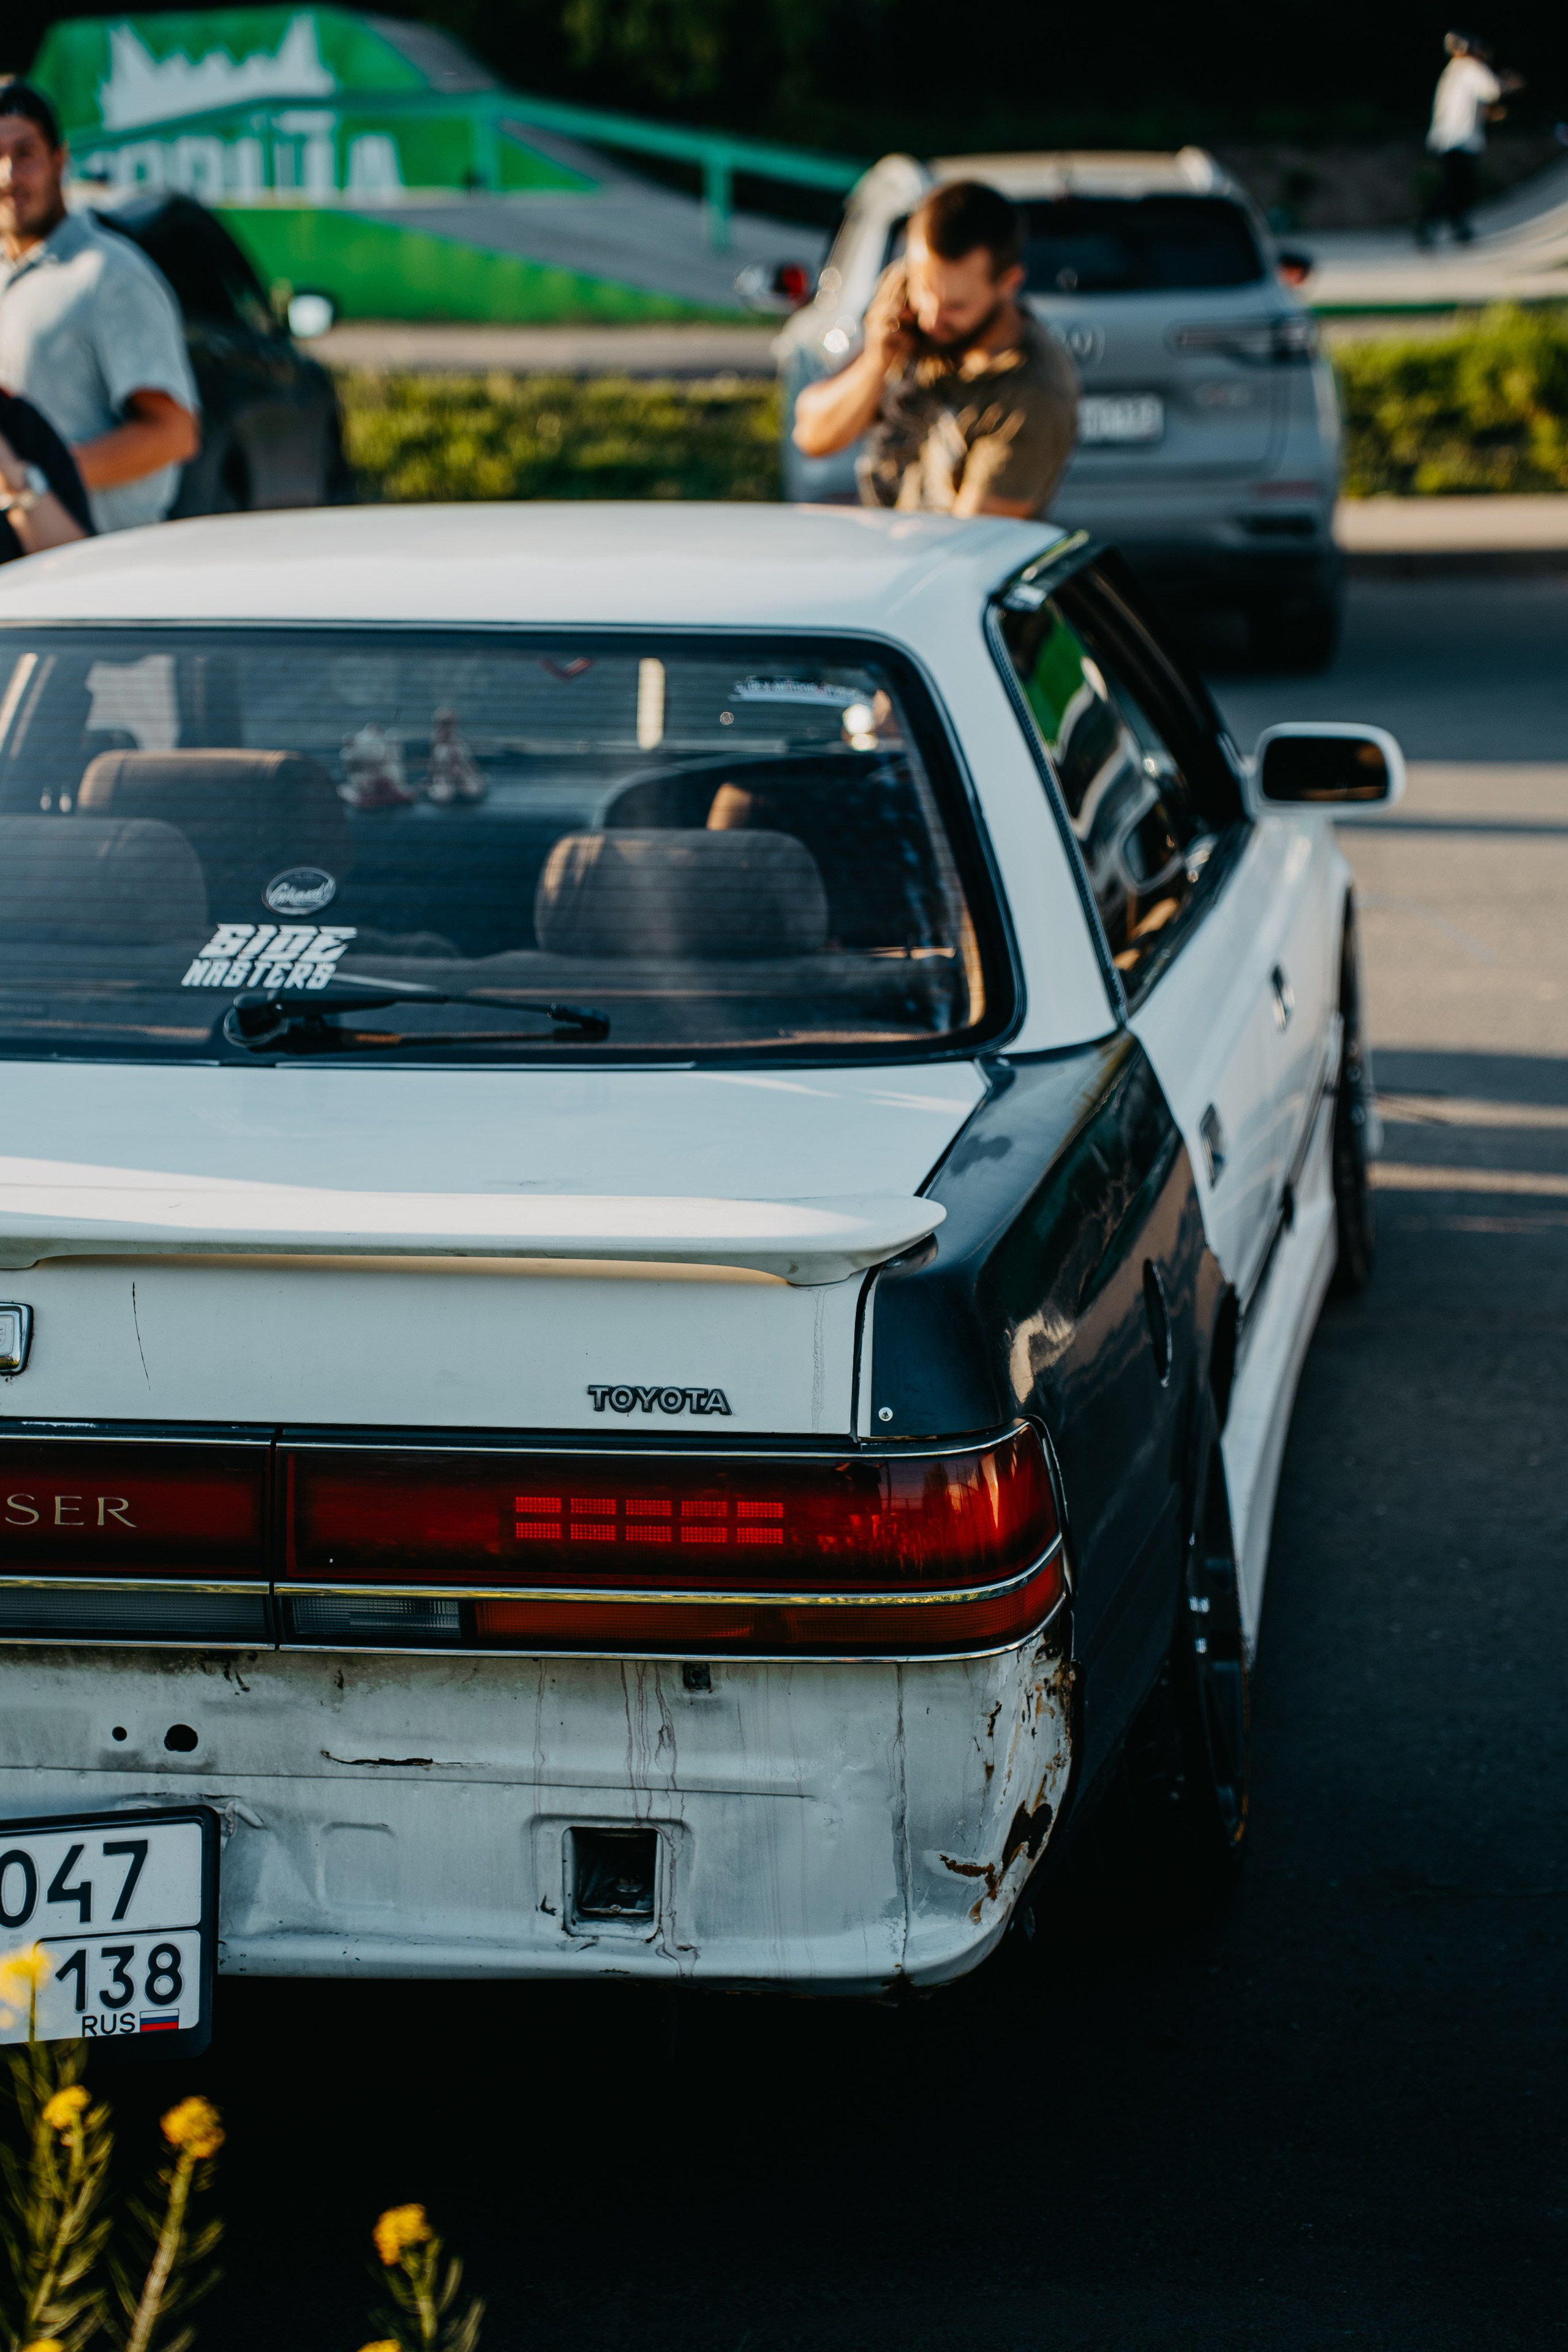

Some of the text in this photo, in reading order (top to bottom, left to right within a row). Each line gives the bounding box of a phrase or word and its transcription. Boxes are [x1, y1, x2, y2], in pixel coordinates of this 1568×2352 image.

[587, 1385, 732, 1415] TOYOTA
[6, 1493, 137, 1528] SER
[0, 1840, 148, 1928] 047
[55, 1943, 183, 2013] 138
[82, 2013, 135, 2037] RUS
